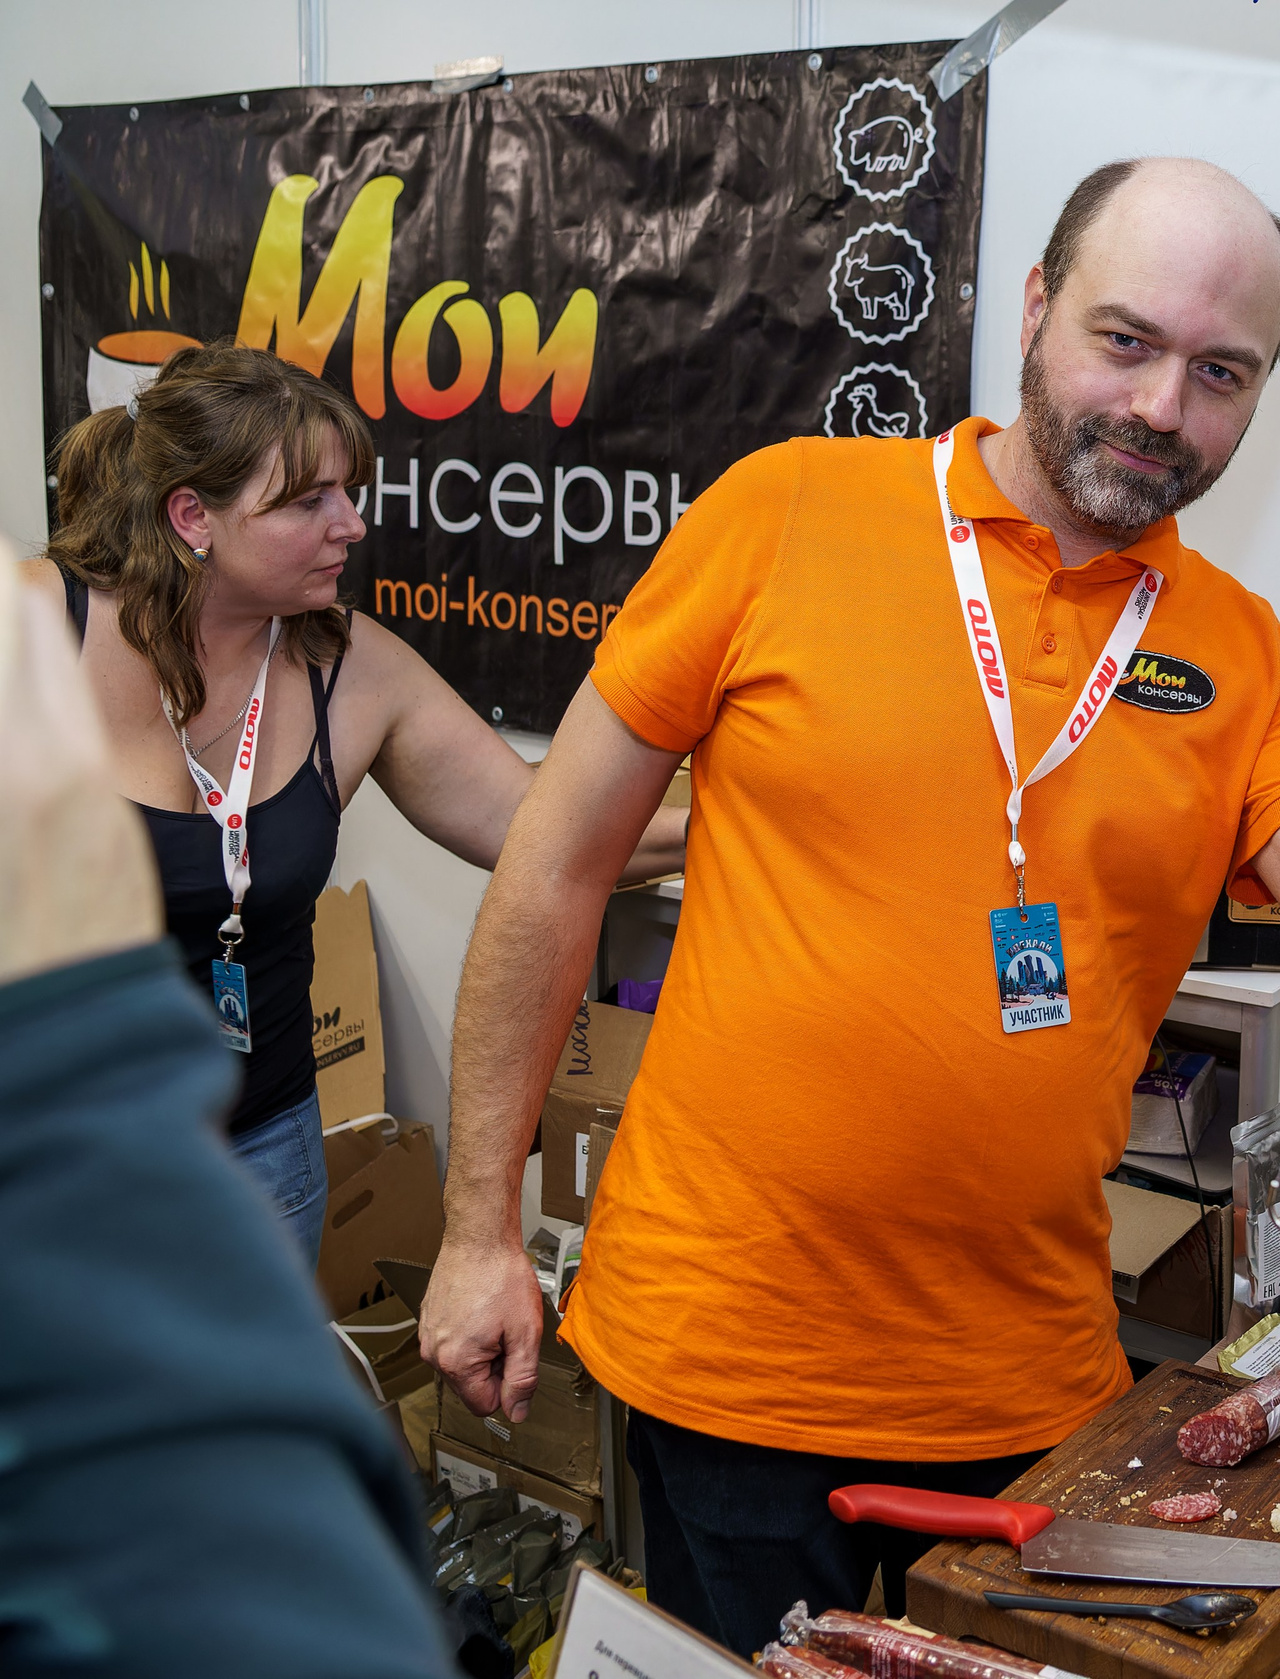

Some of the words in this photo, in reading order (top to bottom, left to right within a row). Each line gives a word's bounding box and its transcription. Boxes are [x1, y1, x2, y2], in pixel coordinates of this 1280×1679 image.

[954, 526, 966, 541] UM
[375, 573, 622, 641] moi-konser
[1134, 587, 1147, 607] MOTORS
[1138, 592, 1151, 616] UNIVERSAL
[1130, 657, 1187, 689] Мои
[1137, 684, 1202, 705] консервы
[231, 816, 238, 827] UM
[1010, 1004, 1065, 1027] УЧАСТНИК
